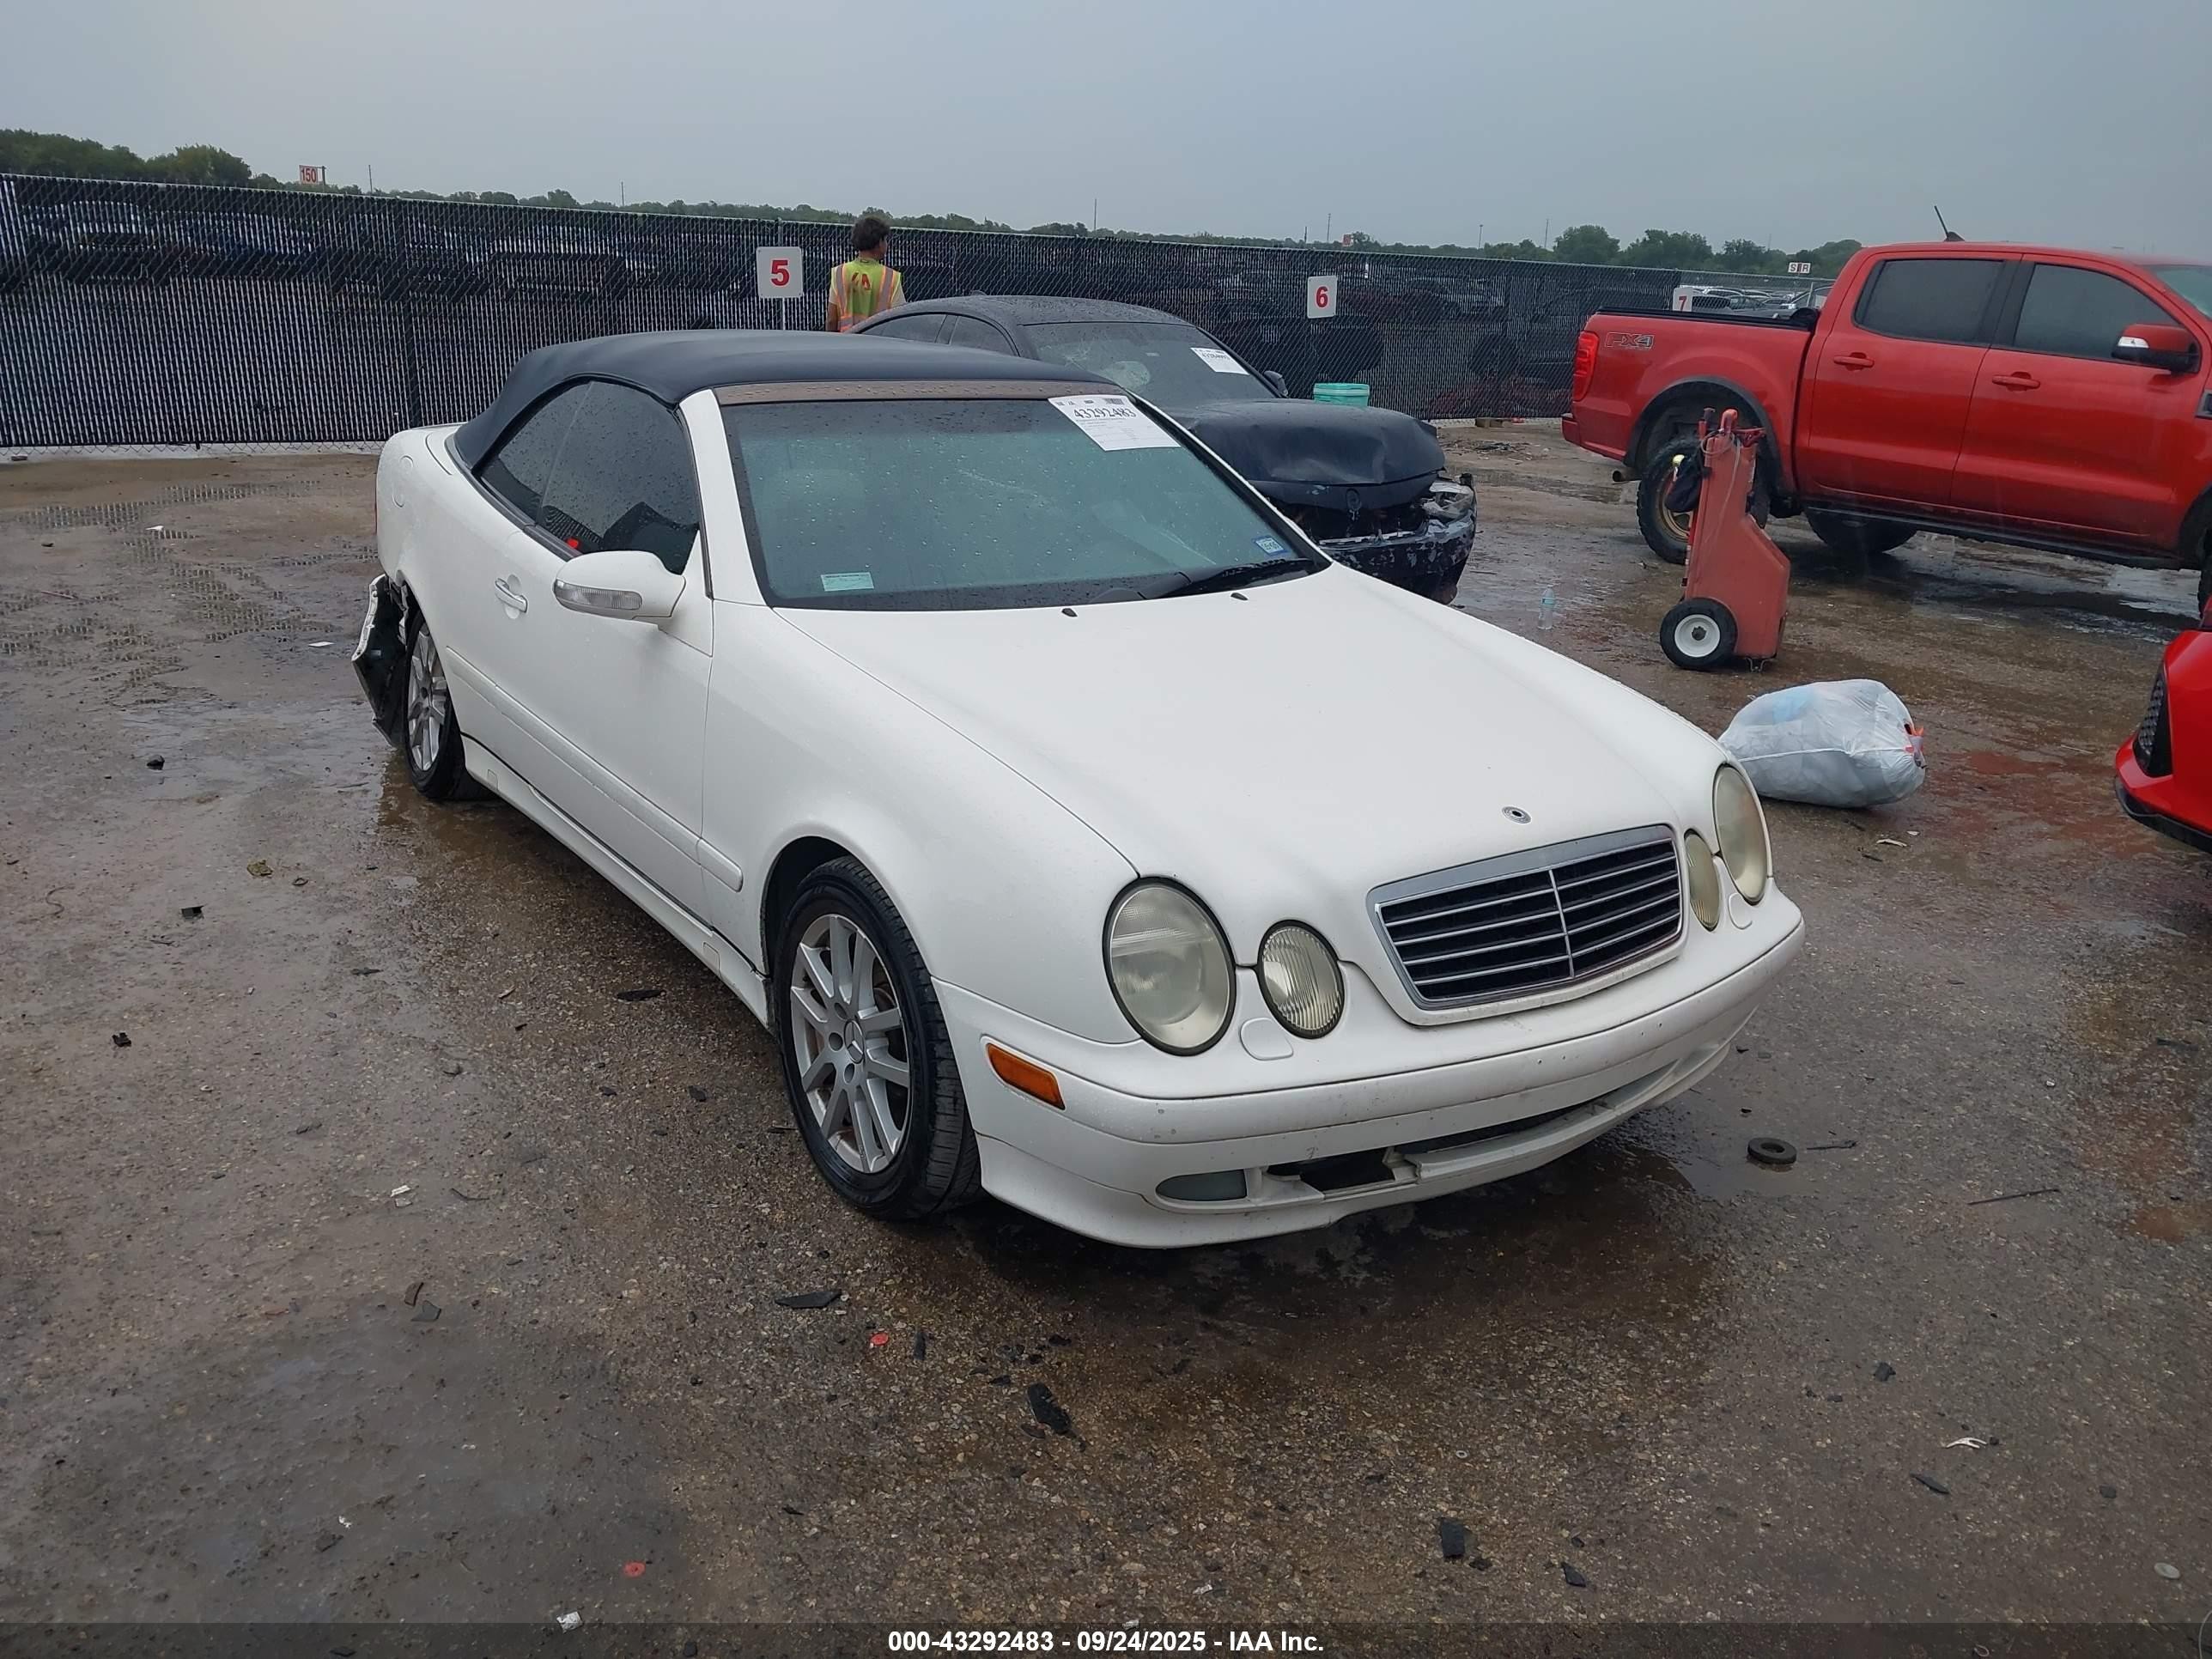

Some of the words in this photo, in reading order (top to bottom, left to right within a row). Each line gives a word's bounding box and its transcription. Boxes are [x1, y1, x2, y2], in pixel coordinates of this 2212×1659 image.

[301, 167, 317, 183] 150
[770, 259, 790, 287] 5
[1316, 285, 1328, 308] 6
[1678, 295, 1687, 312] 7
[1605, 331, 1655, 349] FX4
[1073, 407, 1138, 419] 43292483
